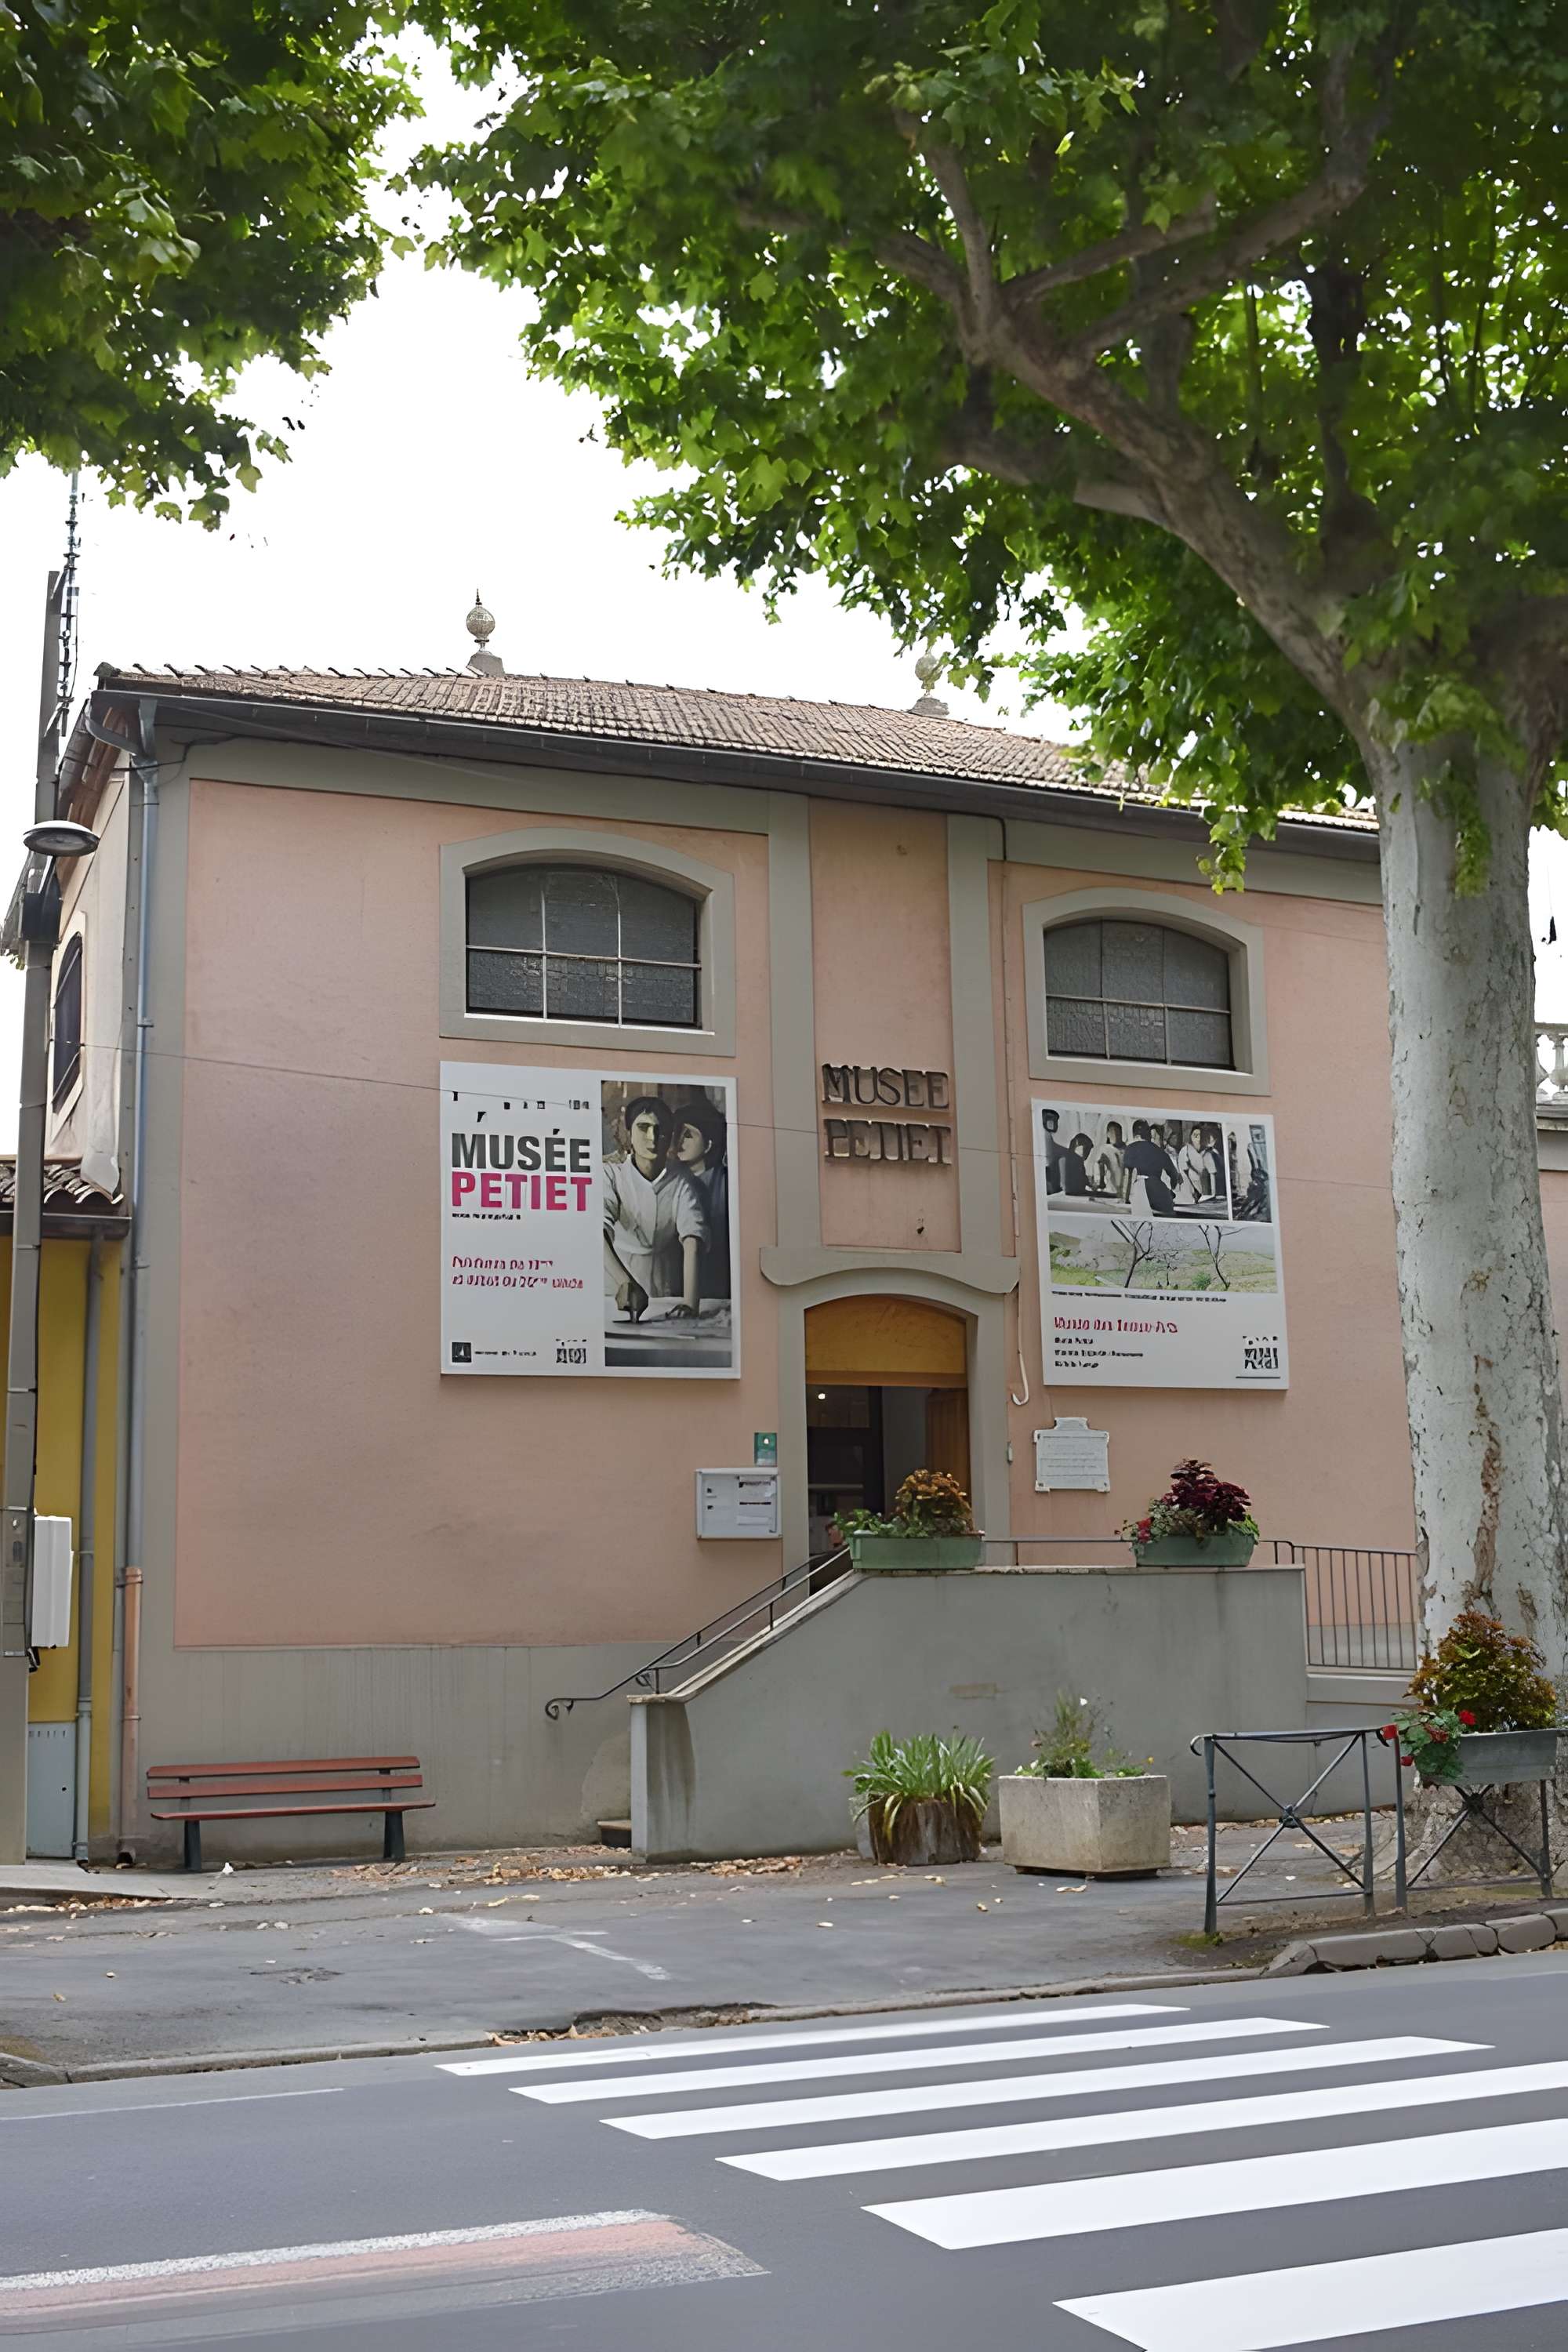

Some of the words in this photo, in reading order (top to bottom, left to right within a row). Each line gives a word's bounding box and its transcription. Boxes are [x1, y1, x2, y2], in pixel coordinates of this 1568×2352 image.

[822, 1064, 949, 1109] MUSEE
[452, 1128, 591, 1173] MUSÉE
[452, 1171, 593, 1211] PETIET
